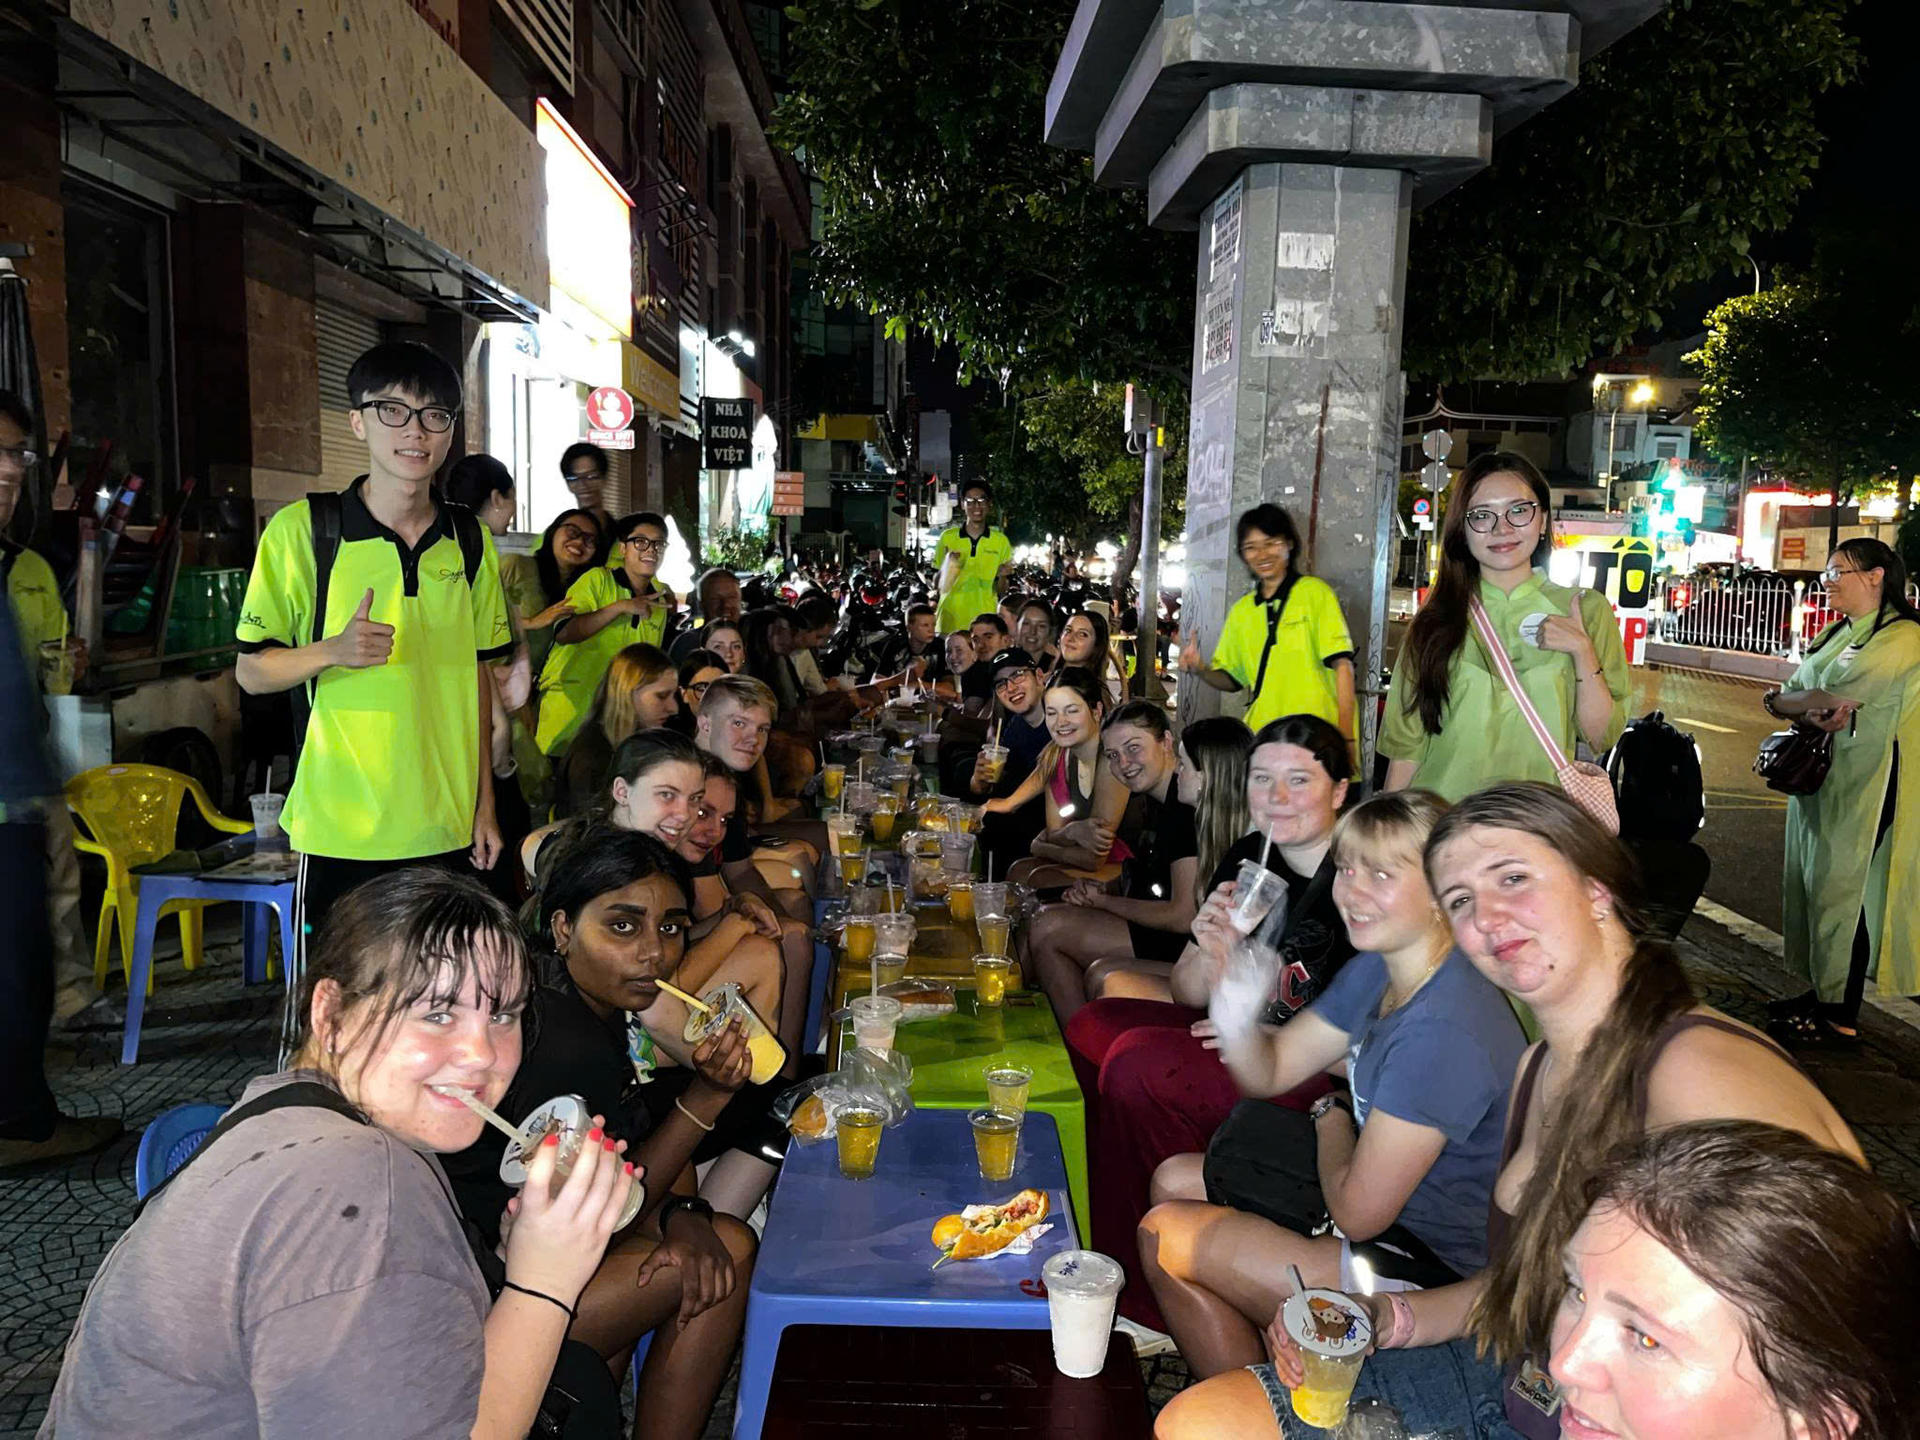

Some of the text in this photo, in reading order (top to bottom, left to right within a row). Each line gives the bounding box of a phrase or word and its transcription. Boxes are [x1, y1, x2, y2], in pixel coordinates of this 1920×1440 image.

[715, 403, 743, 416] NHA
[711, 426, 747, 438] KHOA
[714, 445, 744, 464] VIỆT
